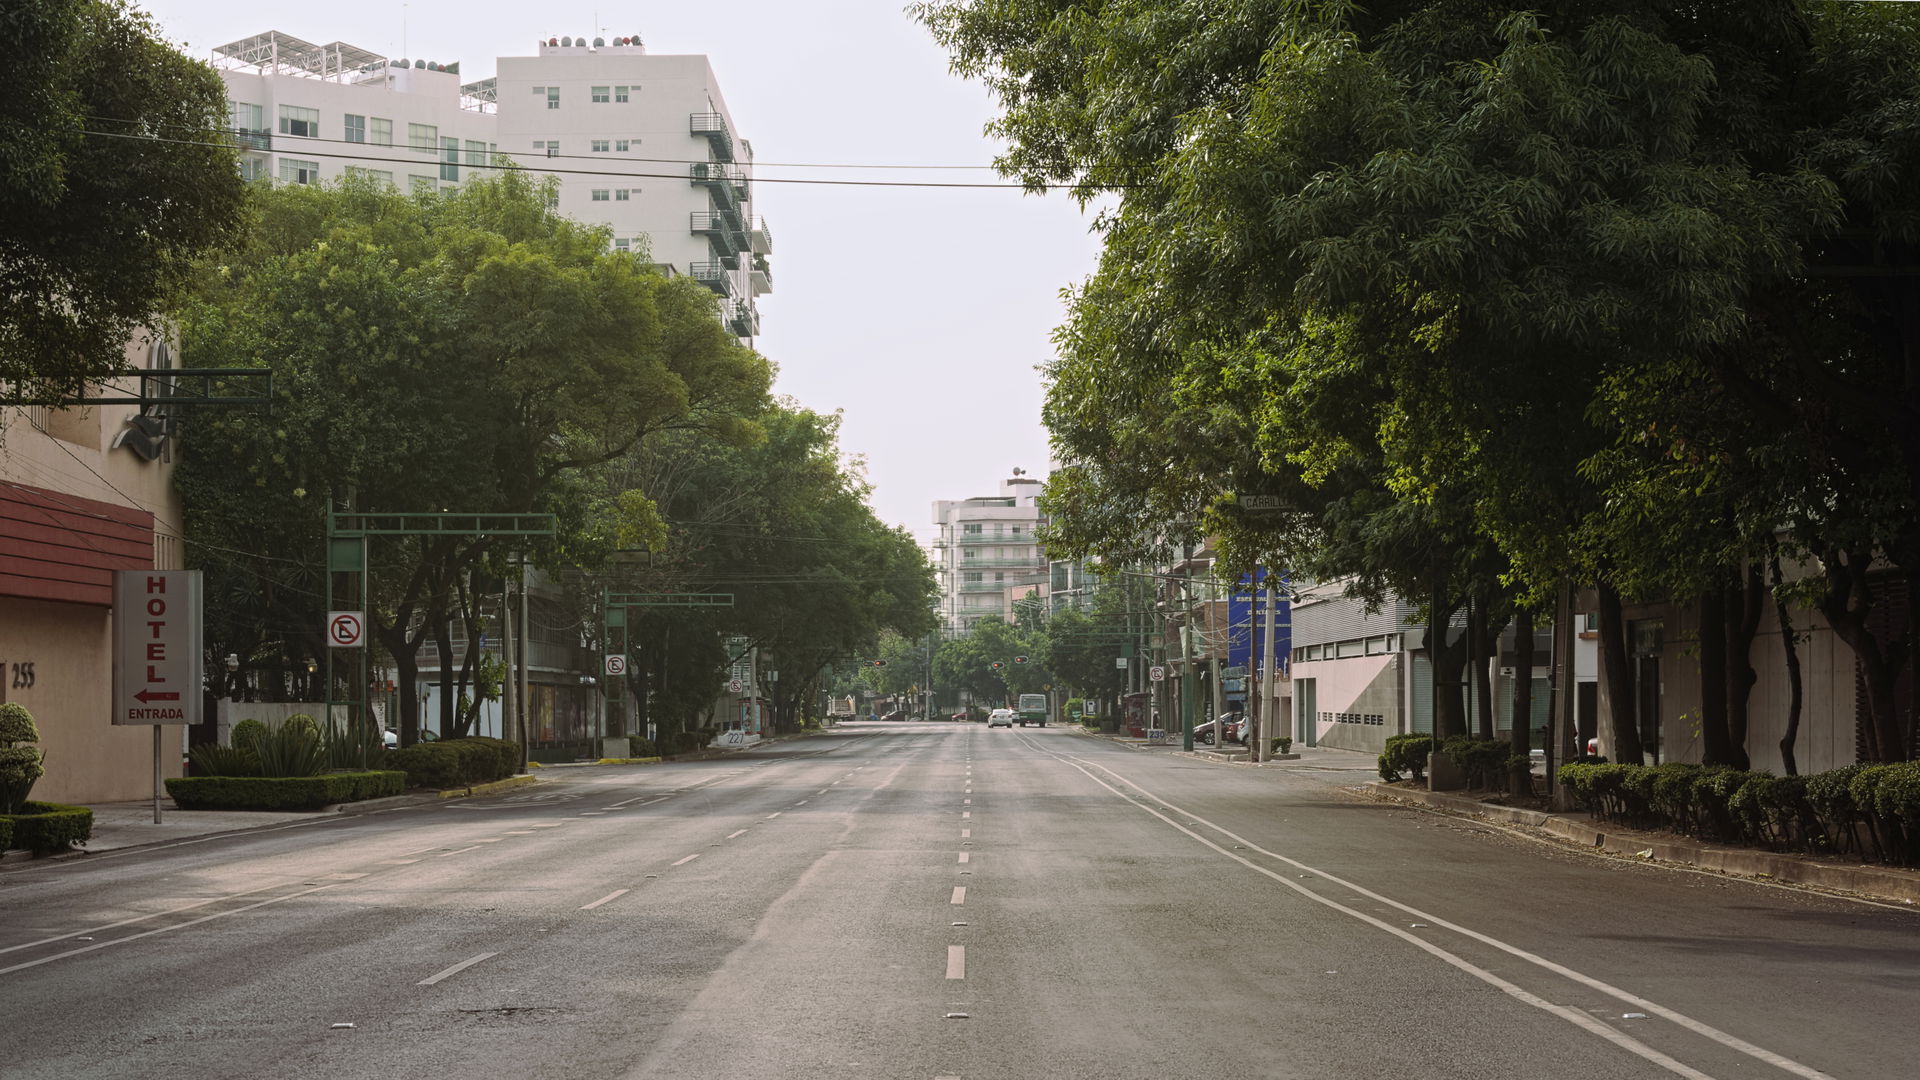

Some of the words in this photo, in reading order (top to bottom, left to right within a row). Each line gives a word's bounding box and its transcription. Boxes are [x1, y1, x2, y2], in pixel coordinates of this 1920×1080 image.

[146, 576, 166, 683] HOTEL
[12, 662, 35, 689] 255
[128, 708, 184, 720] ENTRADA
[728, 732, 744, 744] 227
[1150, 730, 1165, 739] 230
